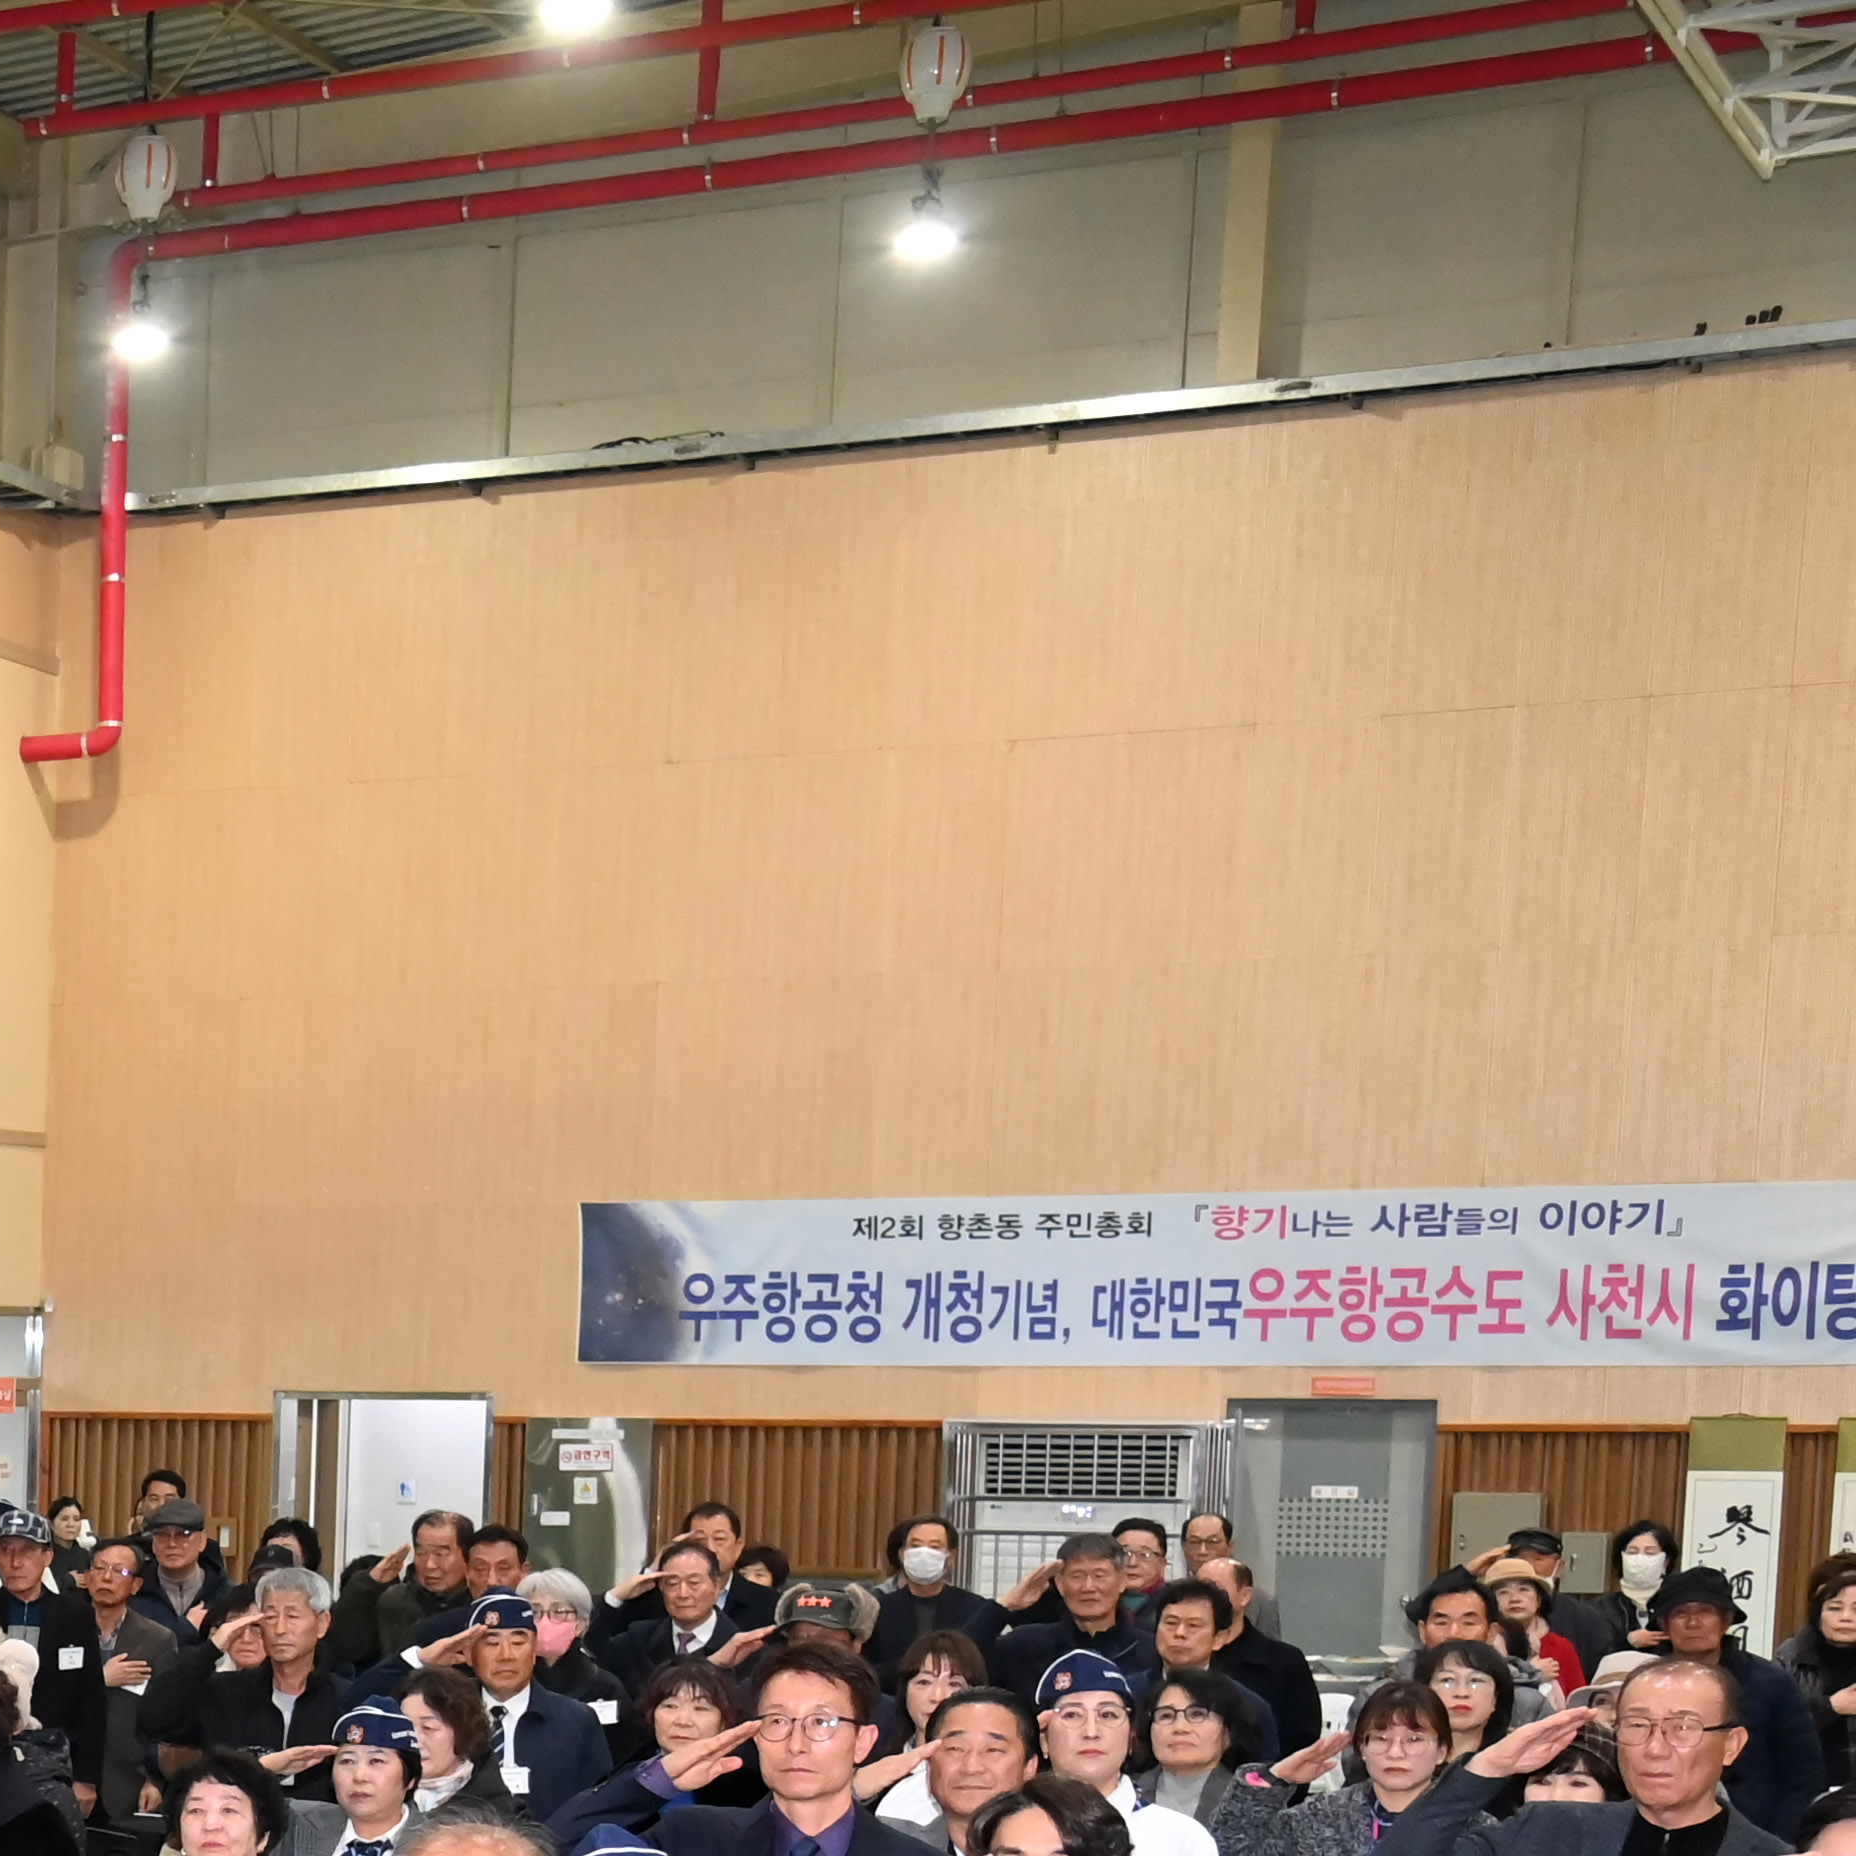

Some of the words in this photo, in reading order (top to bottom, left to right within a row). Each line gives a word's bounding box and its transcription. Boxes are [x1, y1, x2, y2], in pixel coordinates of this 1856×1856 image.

[851, 1214, 924, 1241] 제2회
[937, 1212, 1023, 1240] 향촌동
[1035, 1211, 1152, 1239] 주민총회
[1369, 1202, 1518, 1238] 사람들의
[679, 1270, 883, 1344] 우주항공청
[902, 1270, 1071, 1345] 개청기념,
[1546, 1263, 1695, 1341] 사천시
